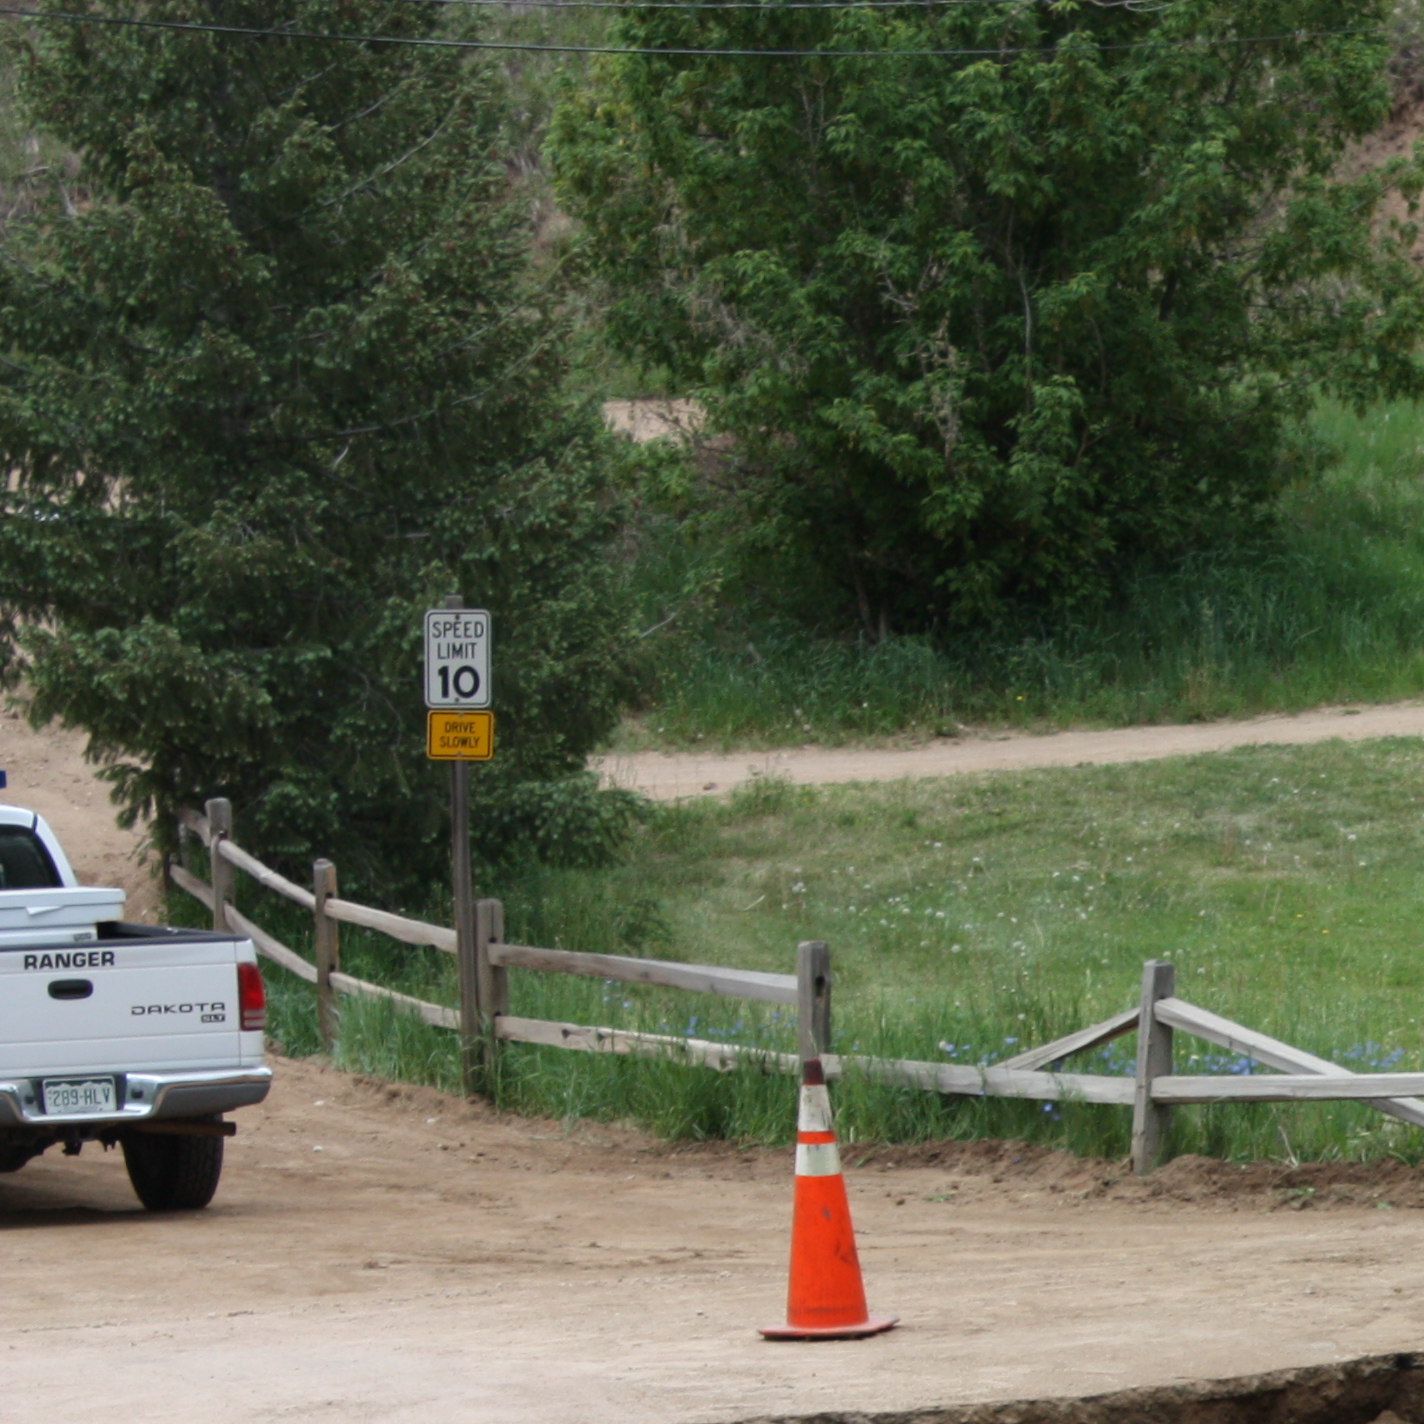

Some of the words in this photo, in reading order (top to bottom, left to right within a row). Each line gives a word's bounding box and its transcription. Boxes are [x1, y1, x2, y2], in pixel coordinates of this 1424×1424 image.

[431, 620, 485, 638] SPEED
[437, 642, 477, 660] LIMIT
[437, 665, 480, 699] 10
[444, 721, 476, 734] DRIVE
[440, 735, 480, 748] SLOWLY
[24, 950, 115, 970] RANGER
[131, 1002, 226, 1015] DAKOTA
